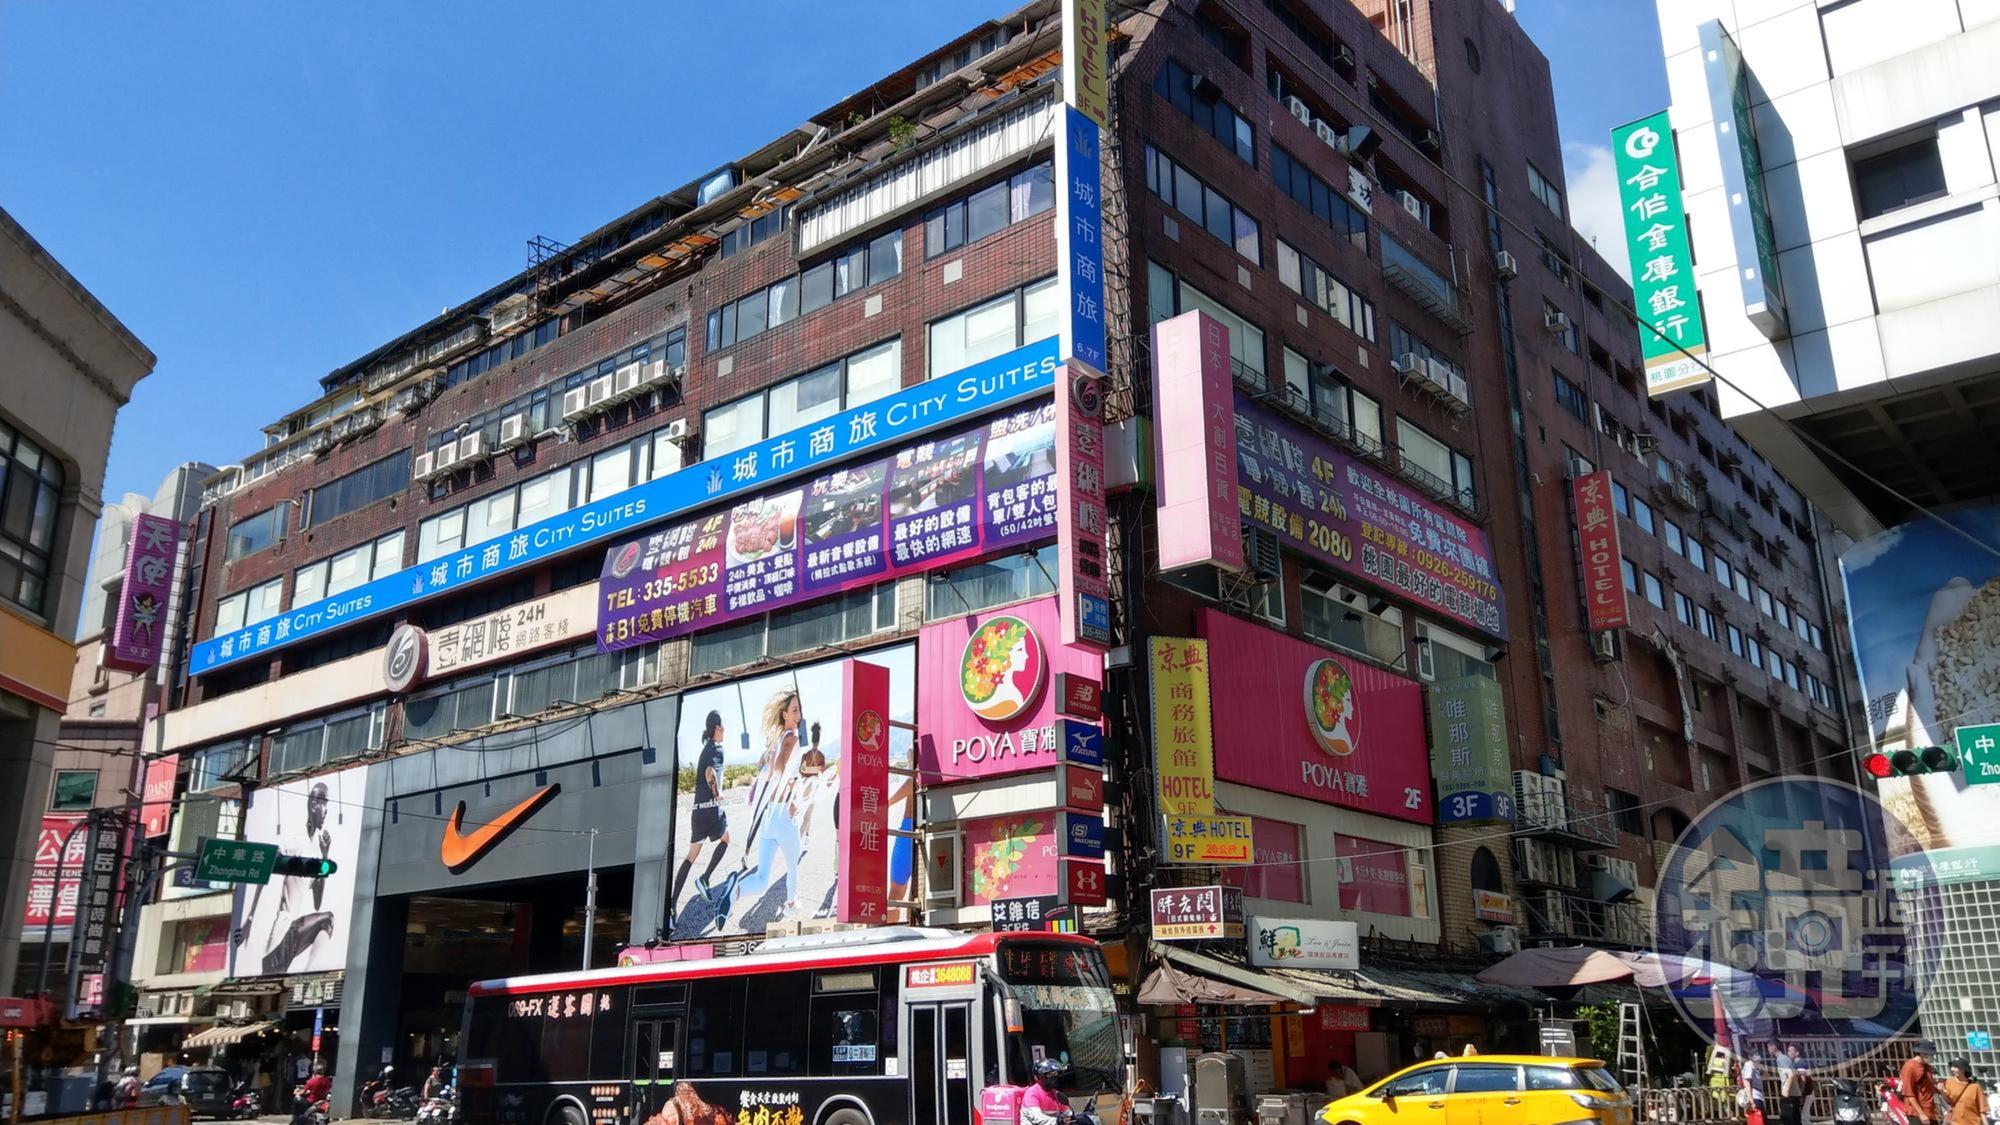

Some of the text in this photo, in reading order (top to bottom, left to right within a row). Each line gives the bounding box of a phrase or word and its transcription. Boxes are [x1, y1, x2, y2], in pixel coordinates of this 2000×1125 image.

[1073, 176, 1098, 325] 城市商旅
[1626, 164, 1690, 342] 合作金庫銀行
[731, 411, 878, 482] 城市商旅
[1311, 455, 1334, 484] 4F
[701, 514, 725, 532] 4F
[894, 504, 972, 542] 最好的設備
[134, 520, 174, 587] 天使
[894, 526, 973, 562] 最快的網速
[1308, 519, 1353, 562] 2080
[429, 534, 528, 588] 城市商旅
[1417, 549, 1498, 601] 0926-259176
[1589, 537, 1615, 605] HOTEL
[643, 562, 719, 602] 335-5533
[516, 602, 546, 627] 24H
[219, 616, 291, 659] 城市商旅
[1157, 643, 1204, 673] 京典
[1170, 682, 1198, 768] 商務旅館
[1446, 698, 1472, 769] 唯那斯
[857, 753, 883, 769] POYA
[952, 726, 1057, 765] POYA 寶雅
[1072, 788, 1095, 801] PUMA
[1162, 775, 1211, 800] HOTEL
[1301, 760, 1369, 798] POYA 寶雅
[1404, 786, 1422, 810] 2F
[1452, 794, 1479, 818] 3F
[1497, 794, 1510, 818] 3F
[859, 784, 880, 852] 寶雅
[1170, 818, 1250, 839] 京典 HOTEL
[213, 845, 265, 864] 中華路
[1173, 842, 1195, 859] 9F
[207, 864, 247, 879] Zhonghua
[860, 902, 876, 917] 2F
[992, 899, 1041, 922] 艾維信
[935, 965, 972, 984] 3648088
